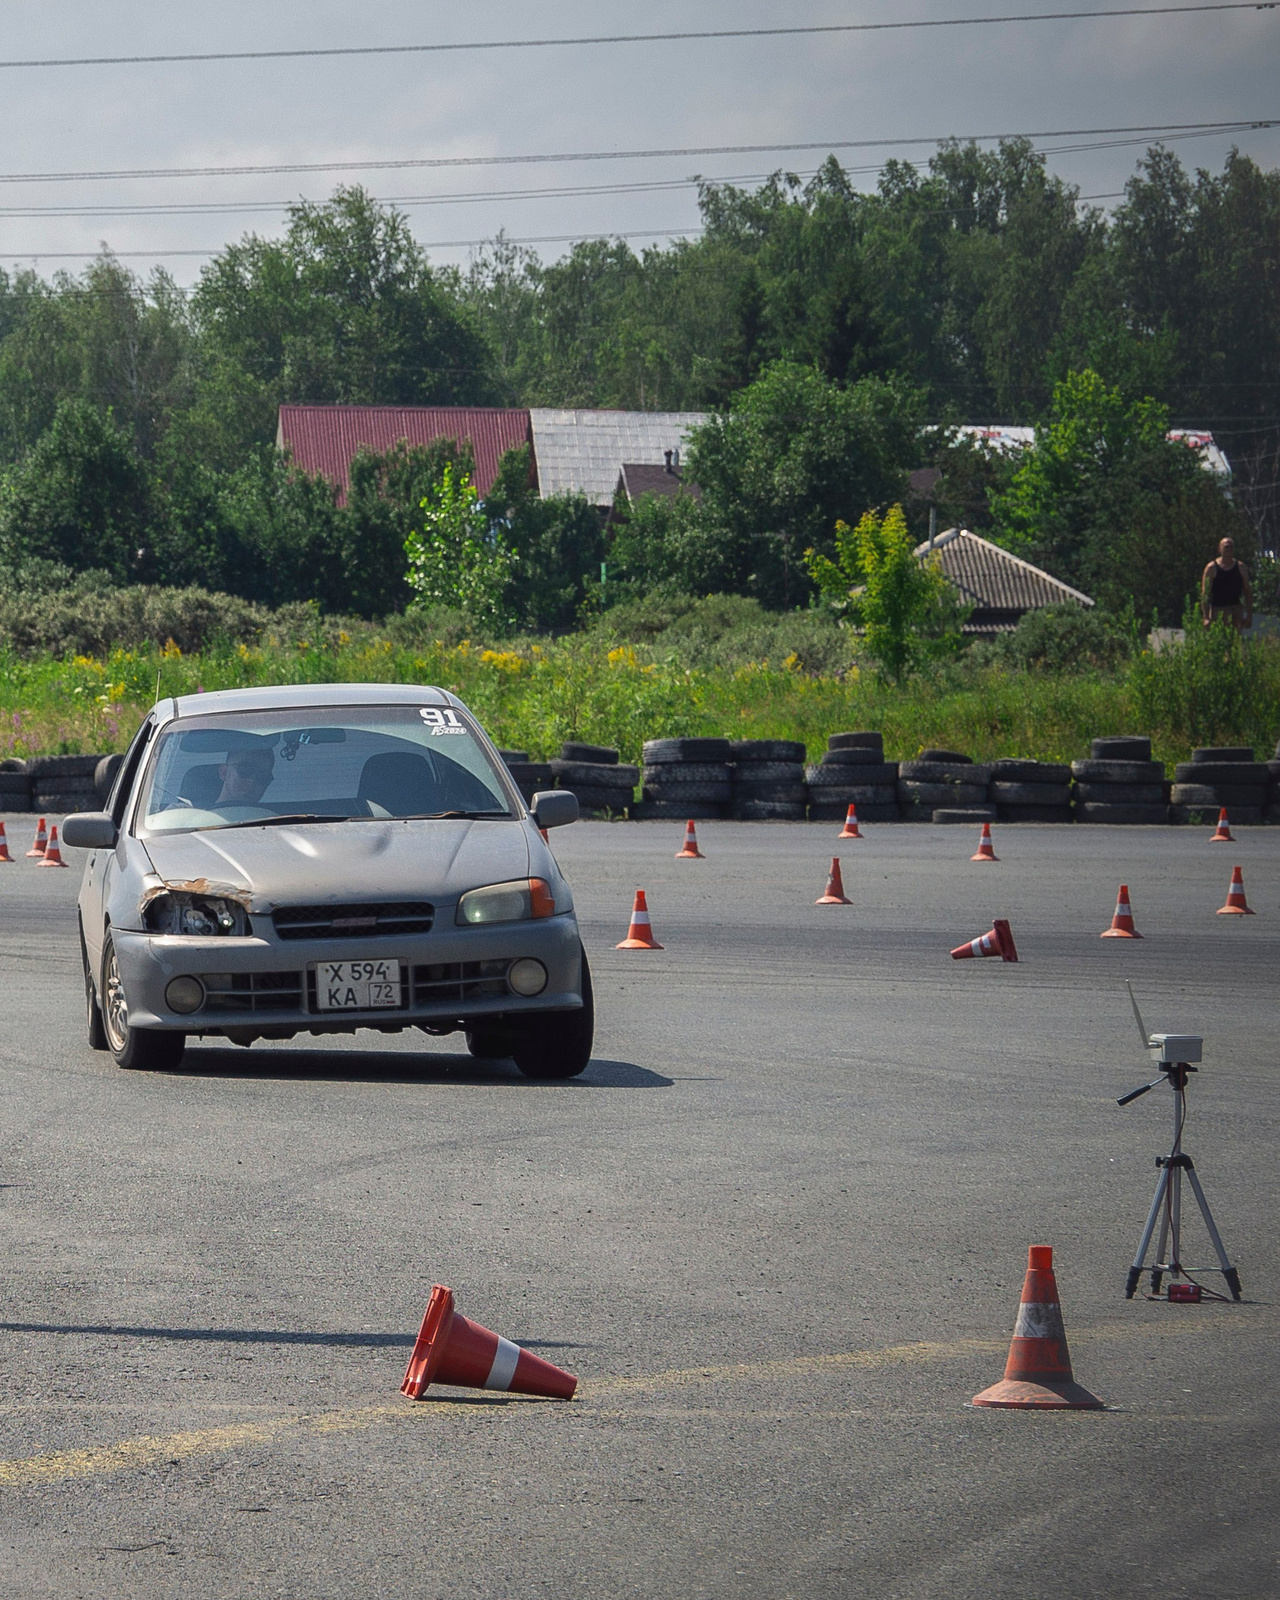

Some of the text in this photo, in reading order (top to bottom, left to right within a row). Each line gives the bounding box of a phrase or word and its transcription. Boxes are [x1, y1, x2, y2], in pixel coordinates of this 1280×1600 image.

[419, 708, 462, 726] 91
[351, 962, 388, 981] 594
[374, 985, 393, 999] 72
